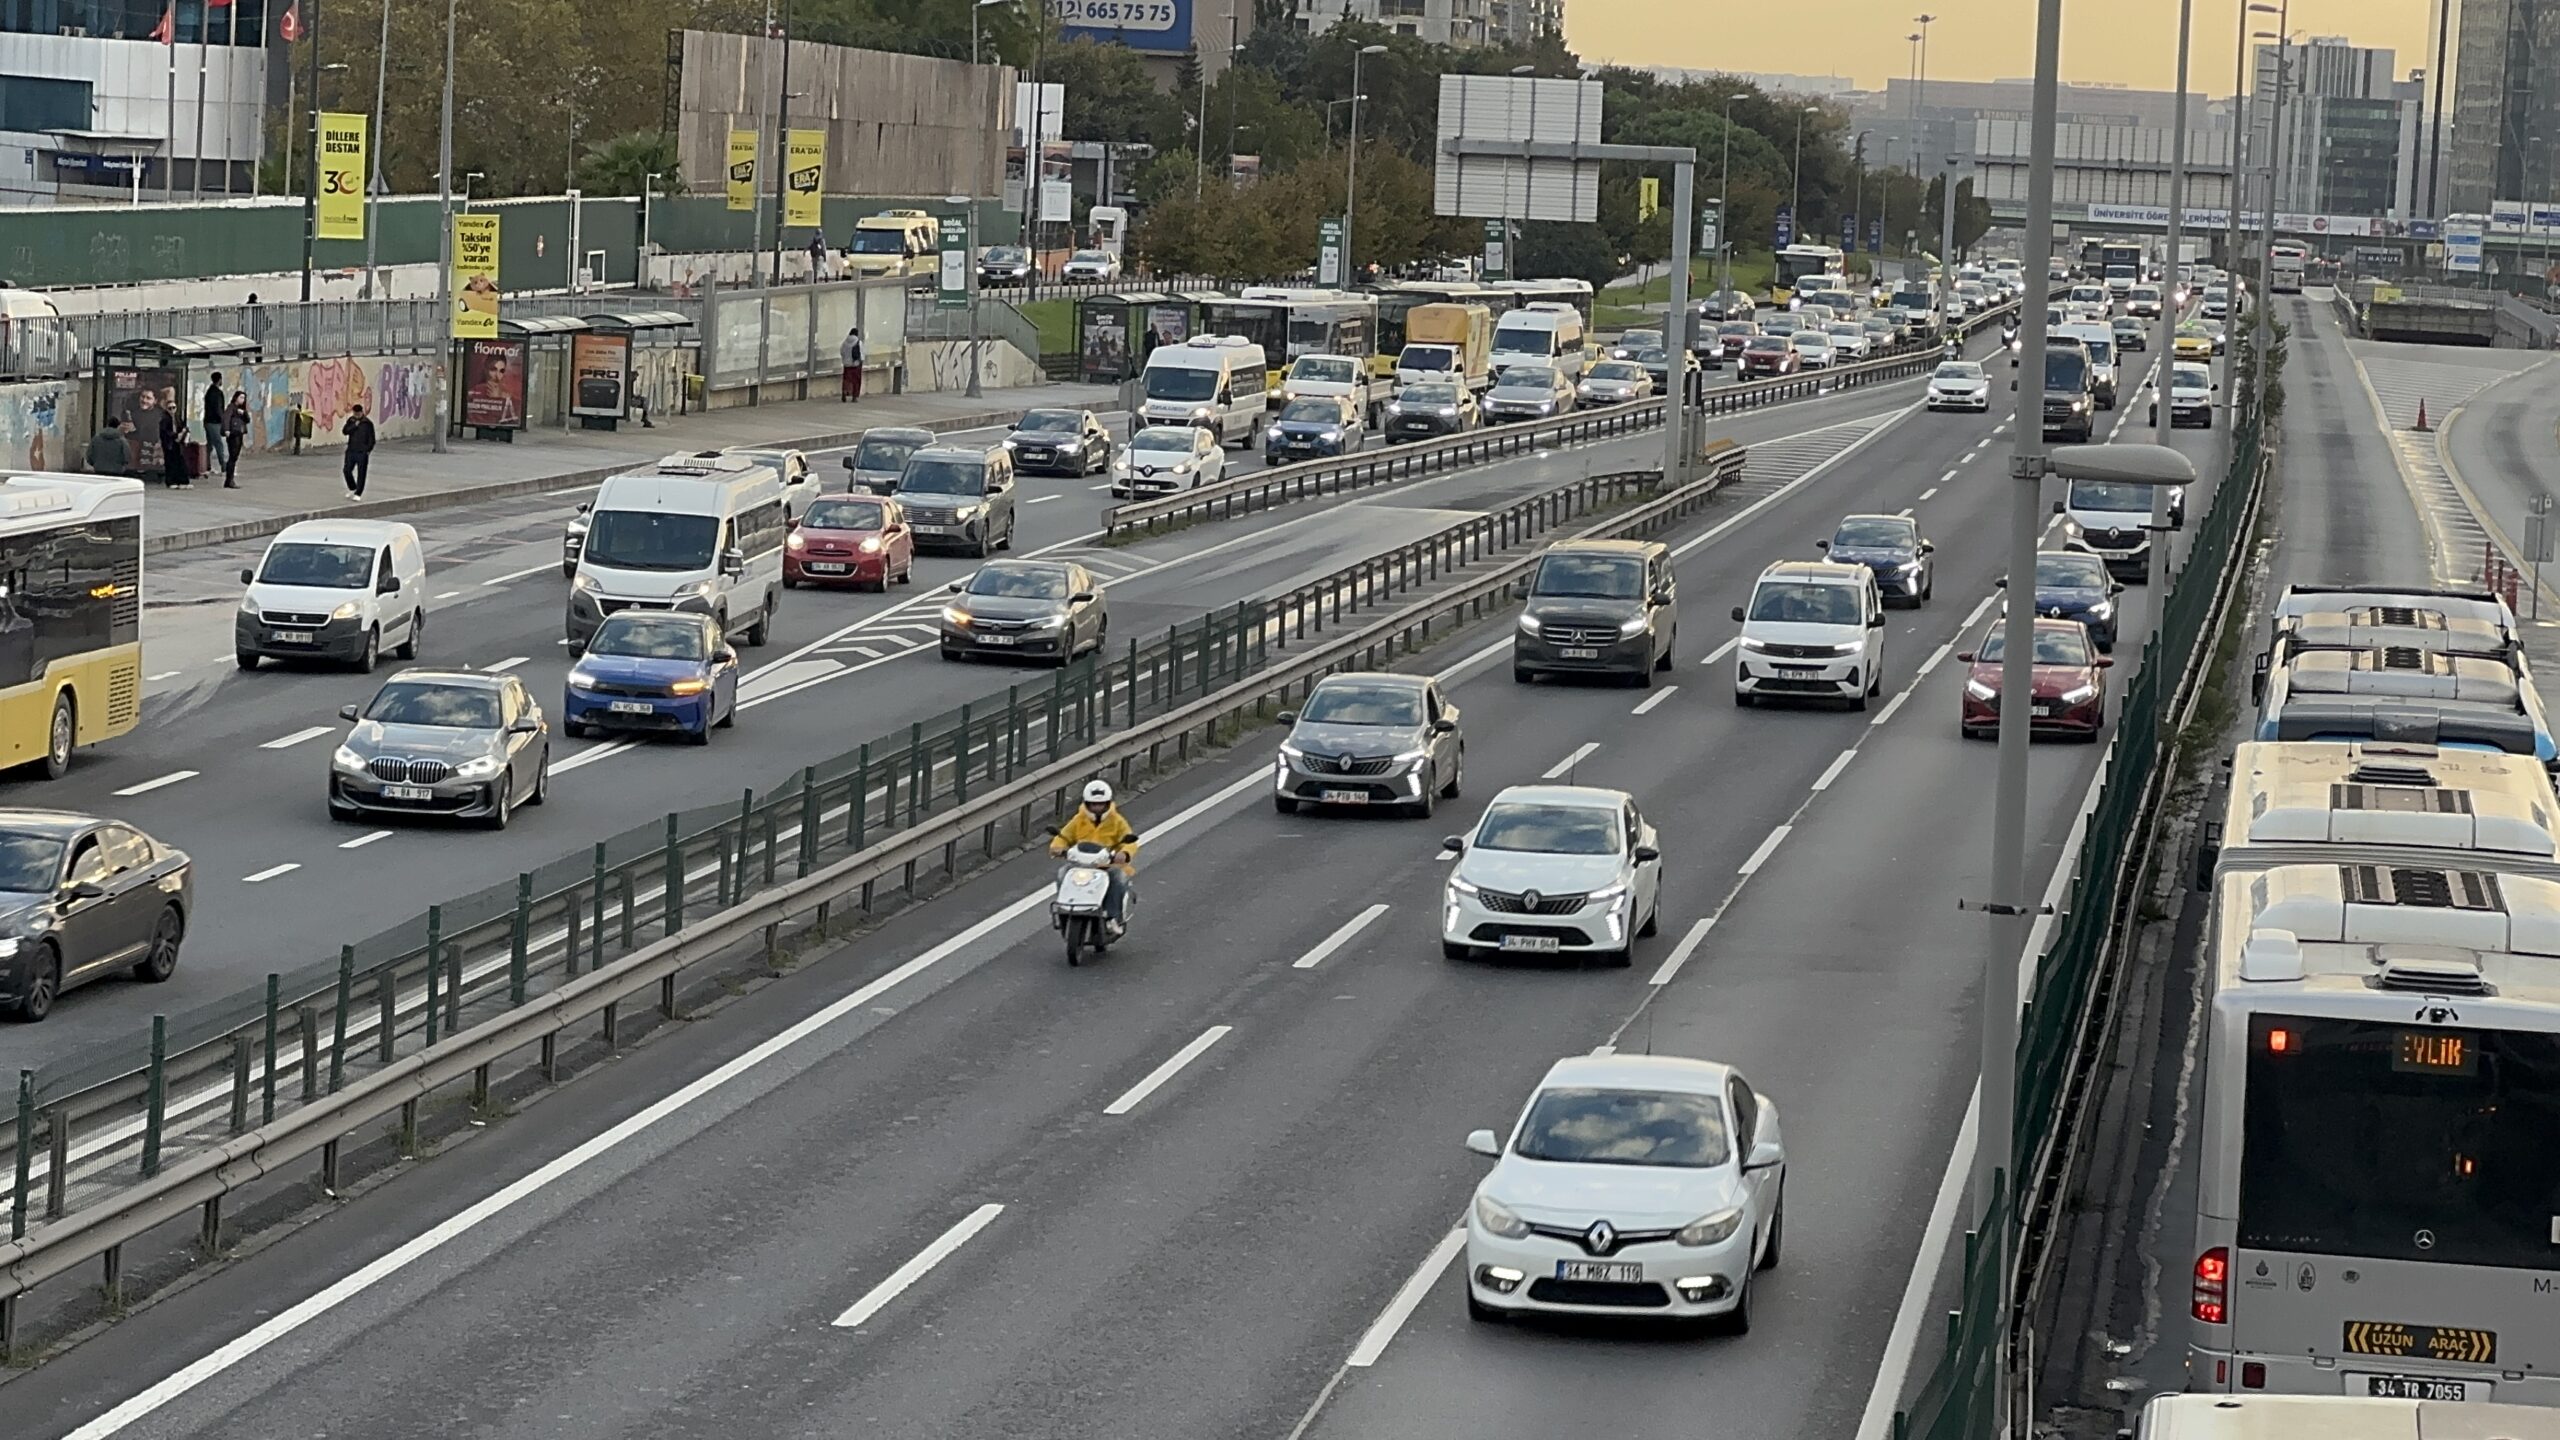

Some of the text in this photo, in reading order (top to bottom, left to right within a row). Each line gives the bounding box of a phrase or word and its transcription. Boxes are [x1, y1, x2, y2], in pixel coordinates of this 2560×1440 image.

[1086, 2, 1118, 19] 665
[1123, 4, 1144, 20] 75
[1149, 5, 1170, 21] 75
[325, 130, 360, 142] DİLLERE
[325, 142, 360, 154] DESTAN
[2093, 208, 2145, 220] ÜNİVERSİTE
[460, 233, 492, 243] Taksini
[462, 243, 491, 254] %50'ye
[463, 255, 489, 263] varan
[474, 341, 519, 357] flormar
[580, 368, 620, 379] PRO
[386, 786, 430, 798] 34 BA 917
[1567, 1265, 1579, 1279] 34
[1620, 1266, 1640, 1282] 119
[2372, 1333, 2469, 1355] UZUN ARAÇ
[2378, 1380, 2462, 1401] 34 TR 7055
